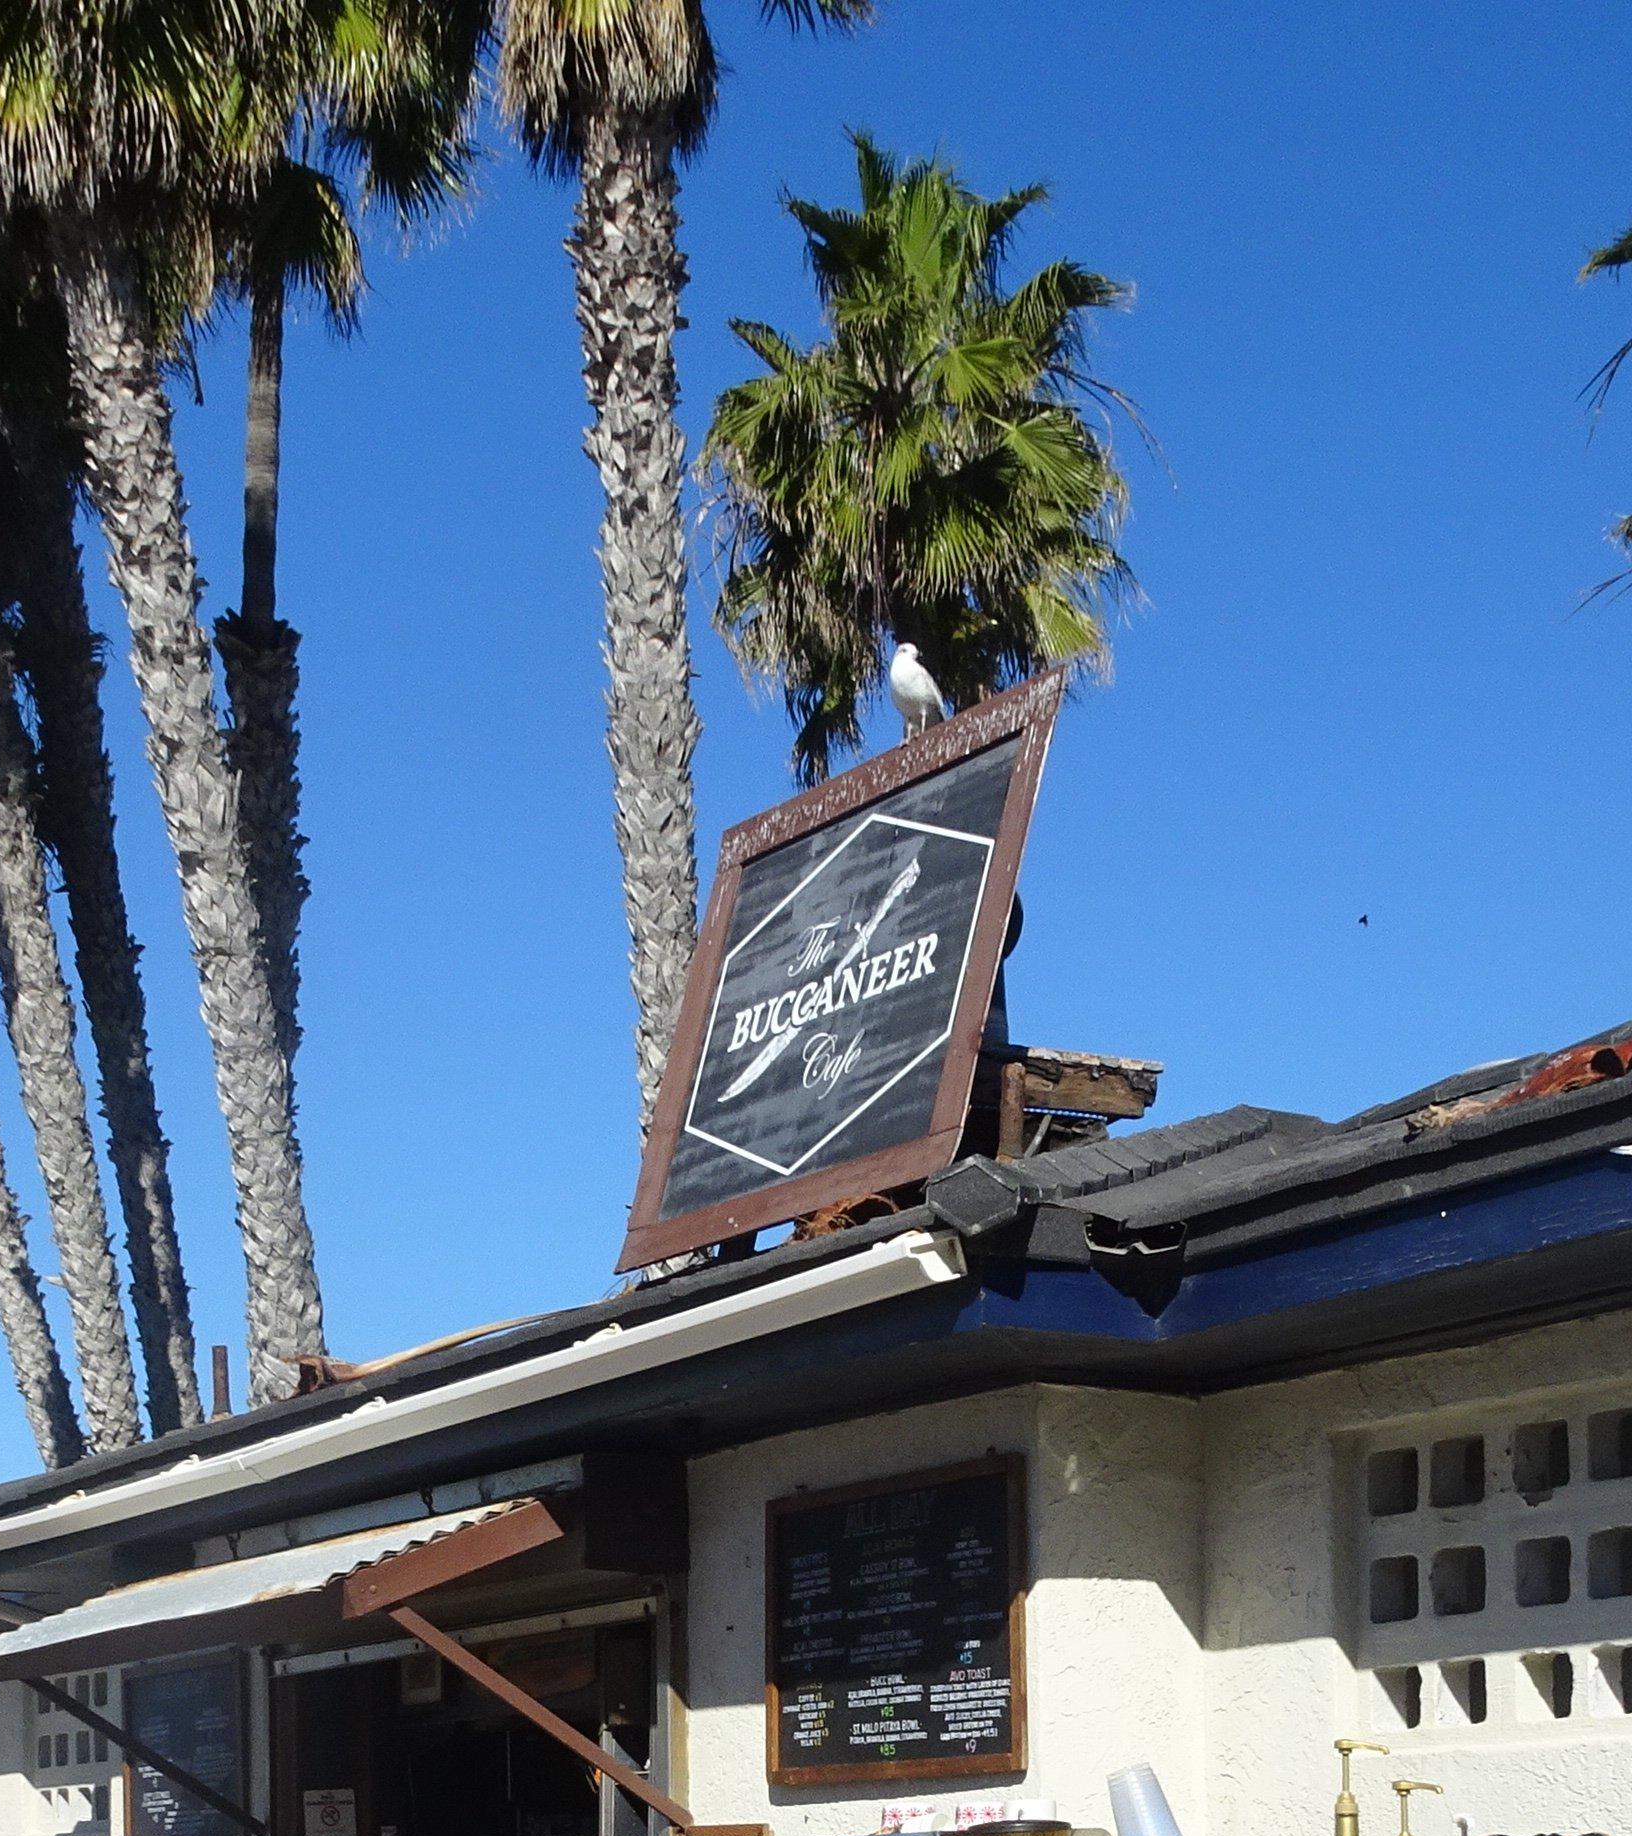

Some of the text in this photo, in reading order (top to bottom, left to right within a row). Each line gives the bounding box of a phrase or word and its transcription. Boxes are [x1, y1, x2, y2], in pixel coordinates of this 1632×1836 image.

[788, 915, 841, 977] The
[727, 932, 938, 1053] BUCCANEER
[802, 1028, 866, 1100] Cafe
[966, 1667, 991, 1679] TOAST
